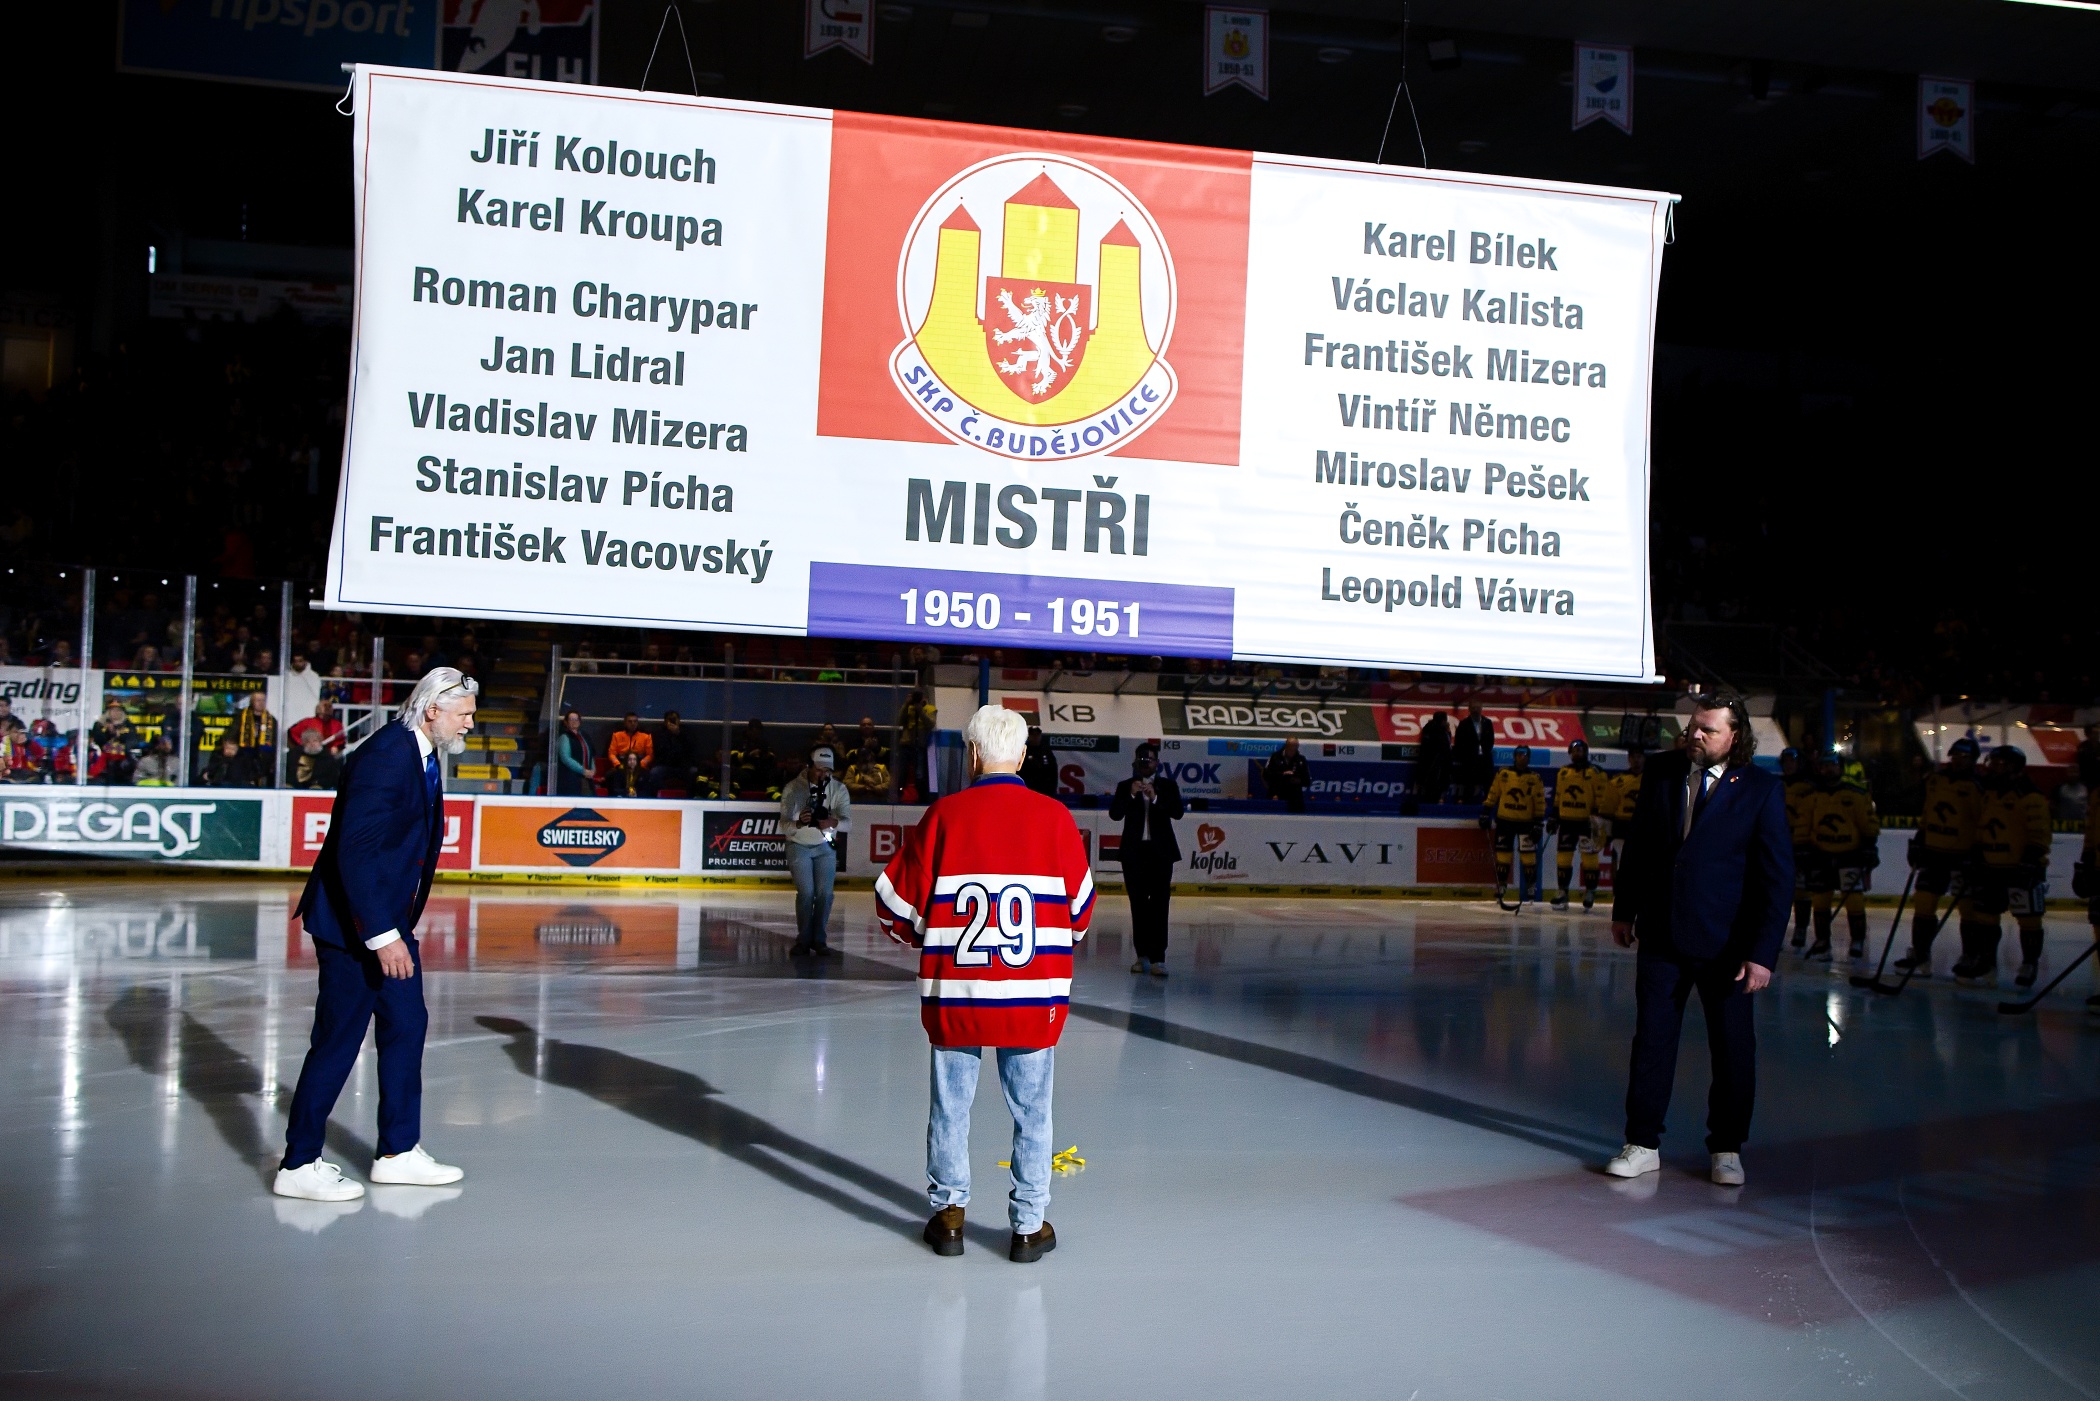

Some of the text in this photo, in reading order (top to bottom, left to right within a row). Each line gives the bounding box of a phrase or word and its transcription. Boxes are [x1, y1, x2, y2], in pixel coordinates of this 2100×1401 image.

[470, 128, 716, 185] Jiří Kolouch
[457, 187, 723, 252] Karel Kroupa
[1363, 221, 1558, 271] Karel Bílek
[413, 266, 758, 335] Roman Charypar
[1331, 276, 1583, 330] Václav Kalista
[480, 335, 685, 387] Jan Lidral
[1304, 332, 1606, 389] František Mizera
[904, 366, 954, 413] SKP
[407, 391, 748, 453] Vladislav Mizera
[1337, 393, 1571, 443] Vintíř Němec
[415, 455, 734, 513] Stanislav Pícha
[1315, 449, 1590, 502] Miroslav Pešek
[905, 474, 1150, 557] MISTŘI
[1339, 501, 1561, 557] Čeněk Pícha
[370, 515, 774, 584] František Vacovský
[900, 588, 1140, 638] 1950 - 1951
[1321, 567, 1574, 616] Leopold Vávra
[1049, 704, 1096, 723] KB
[1184, 703, 1348, 736] RADEGAST
[1049, 736, 1099, 749] RADEGAST
[1163, 740, 1181, 750] KB
[1238, 741, 1278, 753] Tipsport
[1338, 746, 1355, 756] KB
[3, 802, 217, 858] DEGAST
[542, 828, 620, 847] SWIETELSKY
[1265, 841, 1393, 865] VAVI
[475, 873, 503, 881] Tipsport
[534, 874, 562, 882] Tipsport
[593, 874, 620, 882] Tipsport
[651, 875, 679, 884] Tipsport
[708, 857, 757, 867] PROJEKCE
[708, 876, 736, 885] Tipsport
[1190, 850, 1237, 875] kofola
[953, 882, 1036, 969] 29
